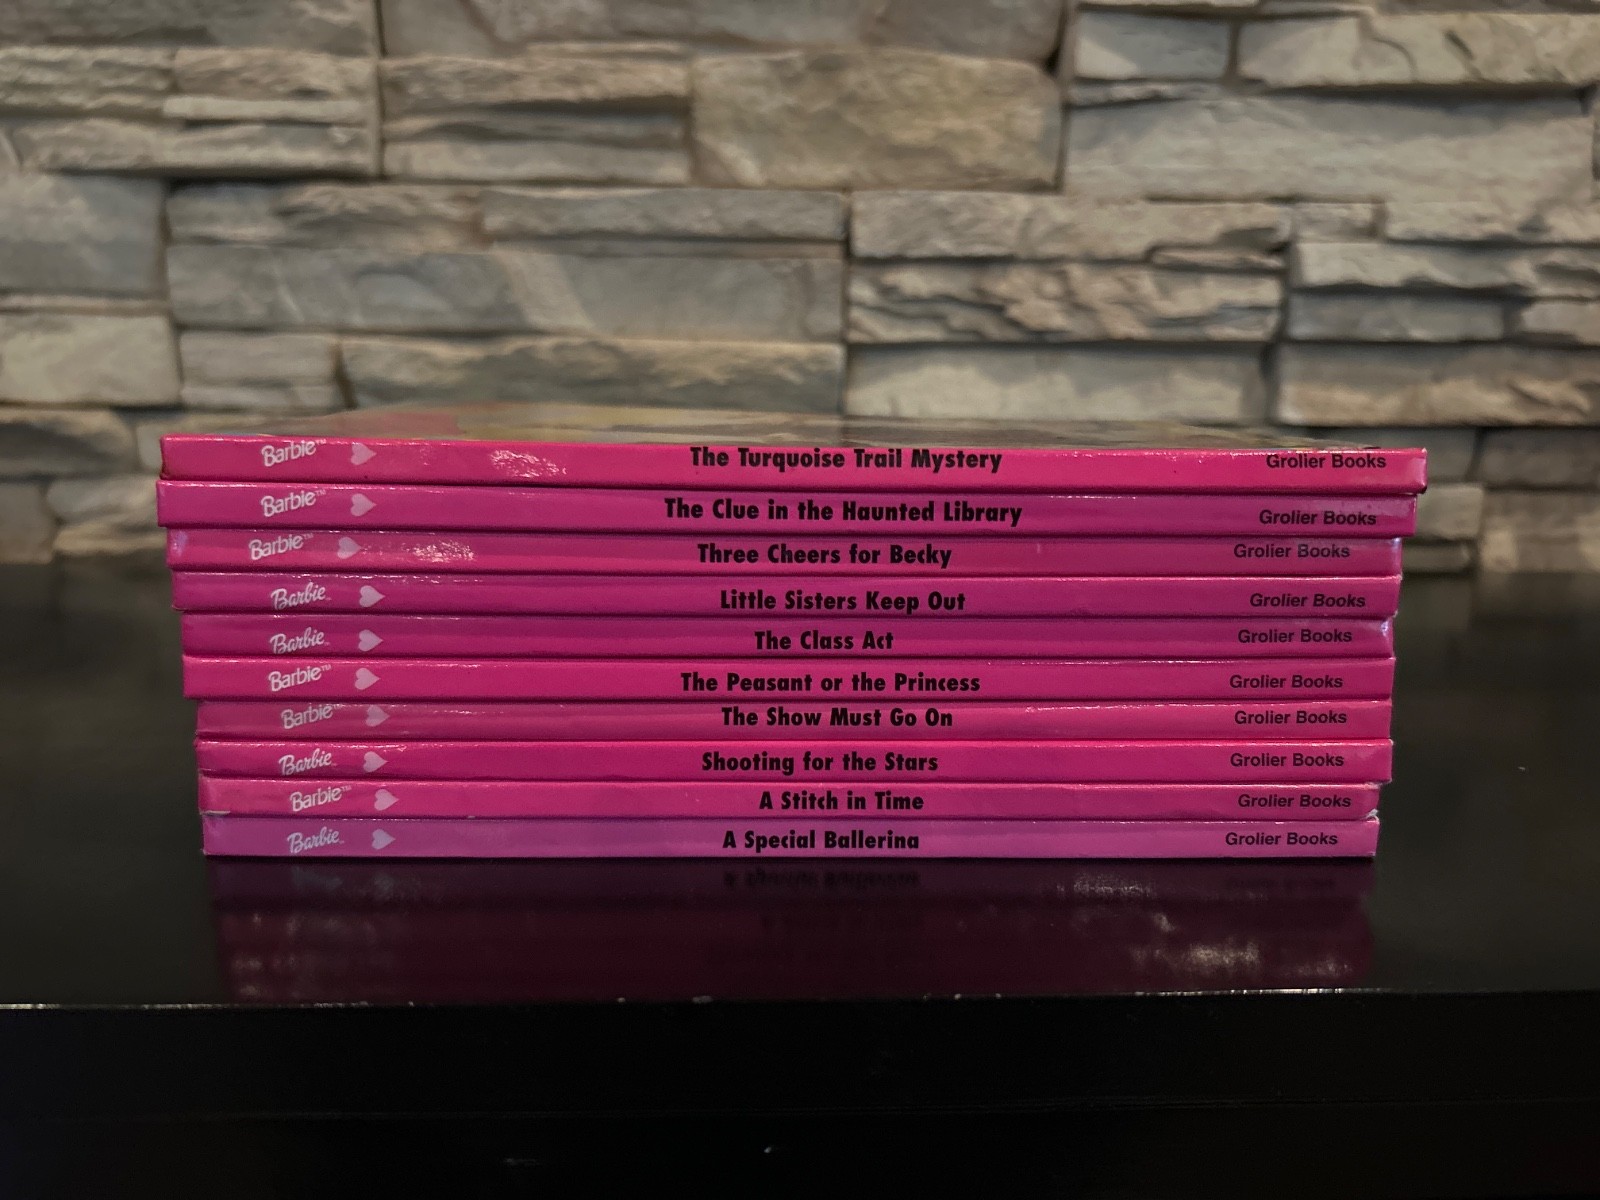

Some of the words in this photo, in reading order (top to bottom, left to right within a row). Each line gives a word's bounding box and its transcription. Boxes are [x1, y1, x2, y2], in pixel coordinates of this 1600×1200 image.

[691, 446, 729, 466] The
[738, 447, 845, 472] Turquoise
[854, 448, 901, 467] Trail
[911, 448, 1002, 473] Mystery
[1266, 454, 1325, 468] Grolier
[1332, 454, 1386, 468] Books
[665, 497, 703, 518] The
[713, 498, 759, 519] Clue
[768, 499, 788, 519] in
[798, 500, 833, 520] the
[843, 501, 934, 521] Haunted
[944, 501, 1022, 527] Library
[1259, 510, 1317, 524] Grolier
[1324, 511, 1376, 525] Books
[698, 543, 758, 563] Three
[768, 544, 840, 563] Cheers
[849, 543, 880, 563] for
[891, 544, 951, 568] Becky
[1234, 544, 1291, 557] Grolier
[1298, 544, 1350, 557] Books
[720, 589, 776, 609] Little
[785, 590, 857, 610] Sisters
[866, 592, 919, 614] Keep
[928, 592, 965, 610] Out
[1250, 593, 1307, 607] Grolier
[1313, 594, 1365, 607] Books
[755, 631, 791, 649] The
[801, 630, 853, 649] Class
[863, 631, 893, 649] Act
[1238, 629, 1294, 643] Grolier
[1301, 629, 1352, 642] Books
[681, 672, 718, 691] The
[727, 673, 812, 691] Peasant
[821, 678, 842, 691] or
[852, 672, 885, 691] the
[895, 672, 980, 691] Princess
[1230, 675, 1286, 688] Grolier
[1292, 675, 1343, 688] Books
[722, 706, 758, 725] The
[767, 707, 821, 725] Show
[830, 708, 881, 726] Must
[891, 708, 916, 726] Go
[926, 708, 952, 726] On
[1235, 711, 1290, 724] Grolier
[1296, 711, 1347, 723] Books
[703, 752, 794, 776] Shooting
[803, 752, 833, 770] for
[843, 752, 876, 770] the
[885, 752, 937, 770] Stars
[1231, 753, 1286, 767] Grolier
[1293, 753, 1344, 766] Books
[760, 792, 773, 809] A
[782, 791, 838, 809] Stitch
[848, 791, 865, 809] in
[875, 791, 923, 809] Time
[1238, 794, 1294, 807] Grolier
[1300, 795, 1351, 807] Books
[723, 831, 736, 848] A
[745, 830, 815, 853] Special
[825, 830, 918, 848] Ballerina
[1226, 832, 1281, 845] Grolier
[1287, 832, 1338, 845] Books
